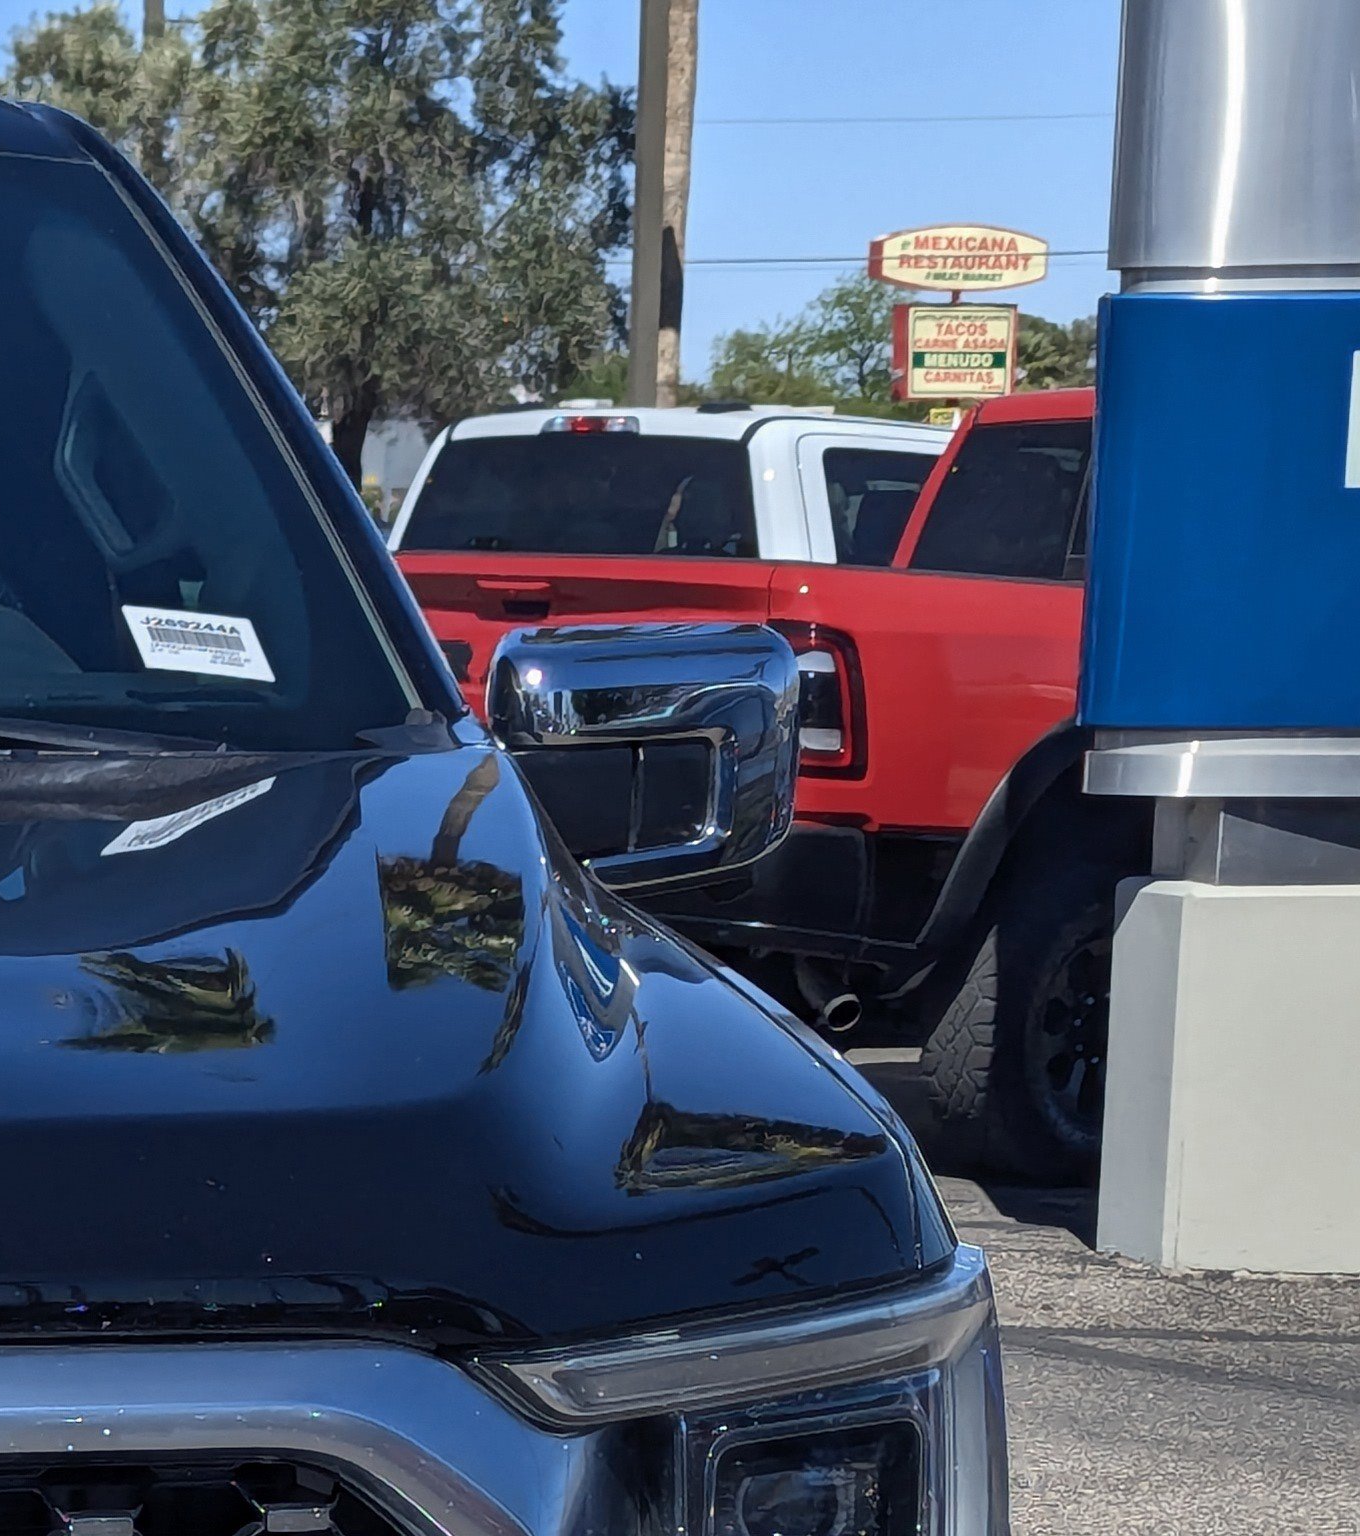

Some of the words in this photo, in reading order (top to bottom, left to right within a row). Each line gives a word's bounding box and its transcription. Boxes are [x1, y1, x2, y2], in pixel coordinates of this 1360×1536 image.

[914, 236, 1018, 252] MEXICANA
[898, 253, 1032, 271] RESTAURANT
[935, 321, 988, 336] TACOS
[914, 338, 958, 349] CARNE
[962, 338, 1006, 350] ASADA
[923, 353, 994, 368] MENUDO
[923, 371, 994, 384] CARNITAS
